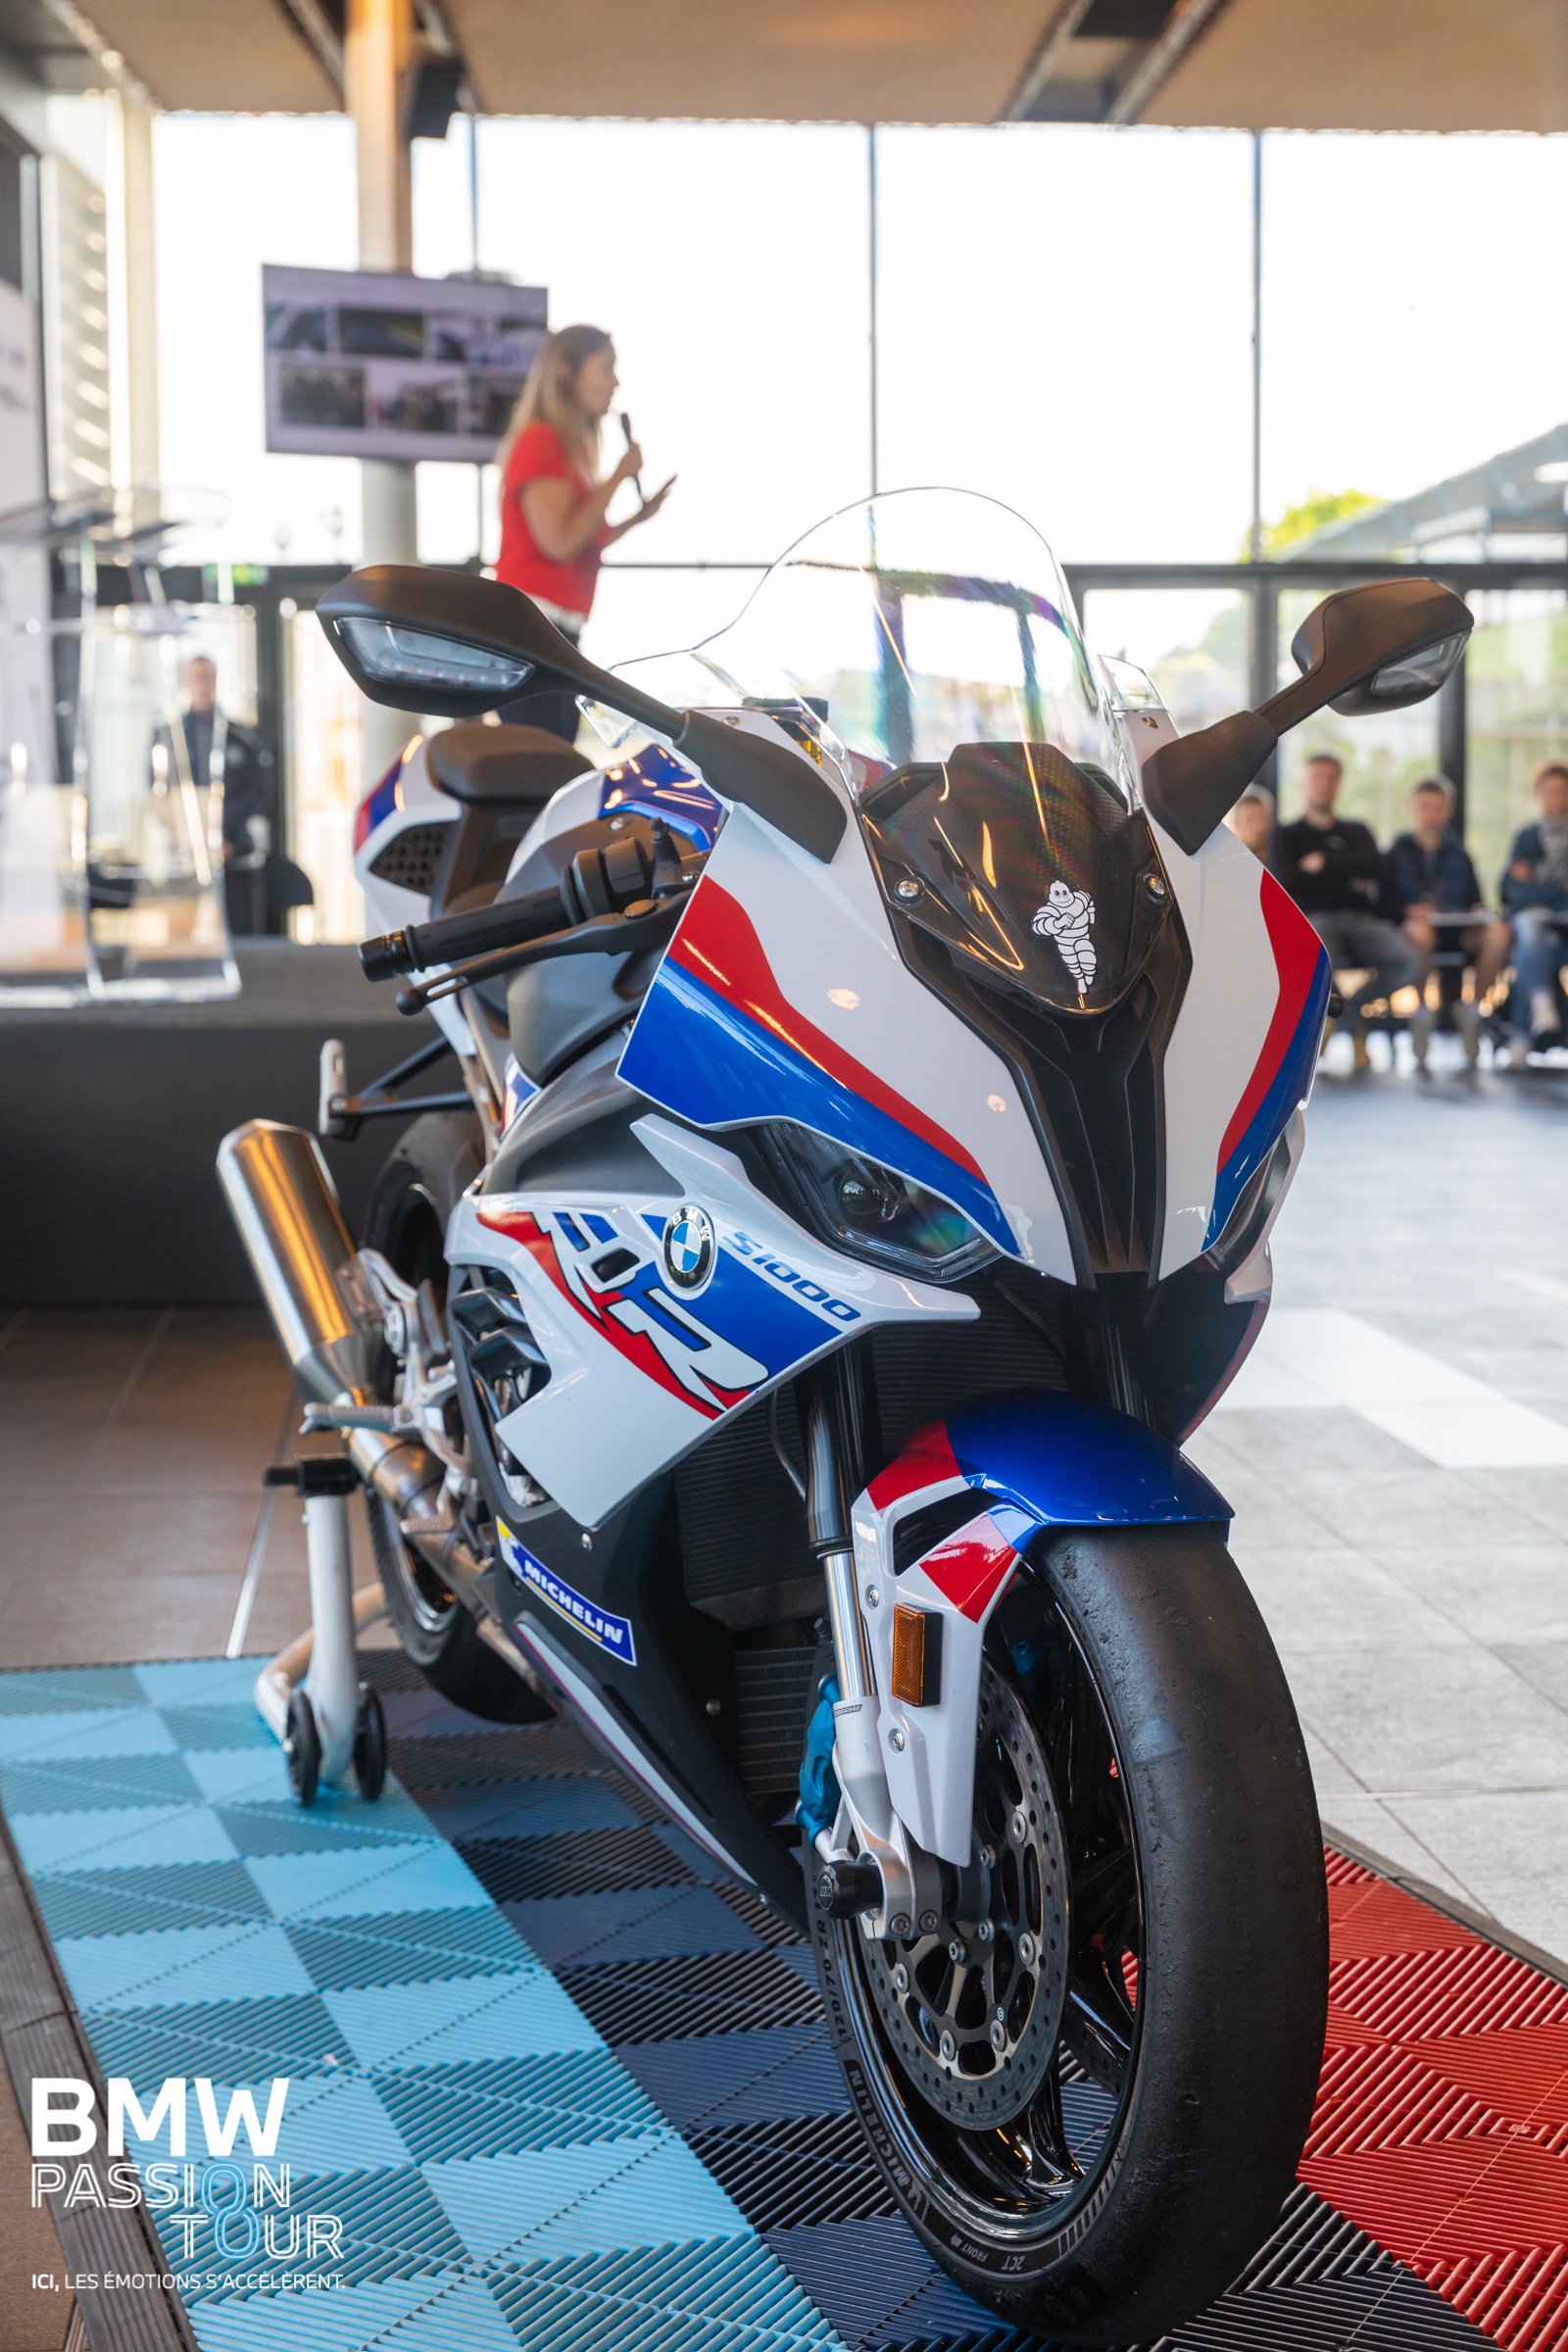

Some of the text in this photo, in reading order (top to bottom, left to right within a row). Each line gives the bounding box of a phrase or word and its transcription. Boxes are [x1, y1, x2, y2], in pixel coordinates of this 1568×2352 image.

[671, 1207, 710, 1242] BMW
[721, 1231, 861, 1322] S1000
[524, 1559, 623, 1644] MICHELIN
[817, 1919, 829, 1949] ZR
[823, 1958, 848, 2037] 120/70
[849, 2069, 910, 2186] MICHELIN
[960, 2242, 988, 2263] FRONT
[1001, 2255, 1026, 2271] 2CT
